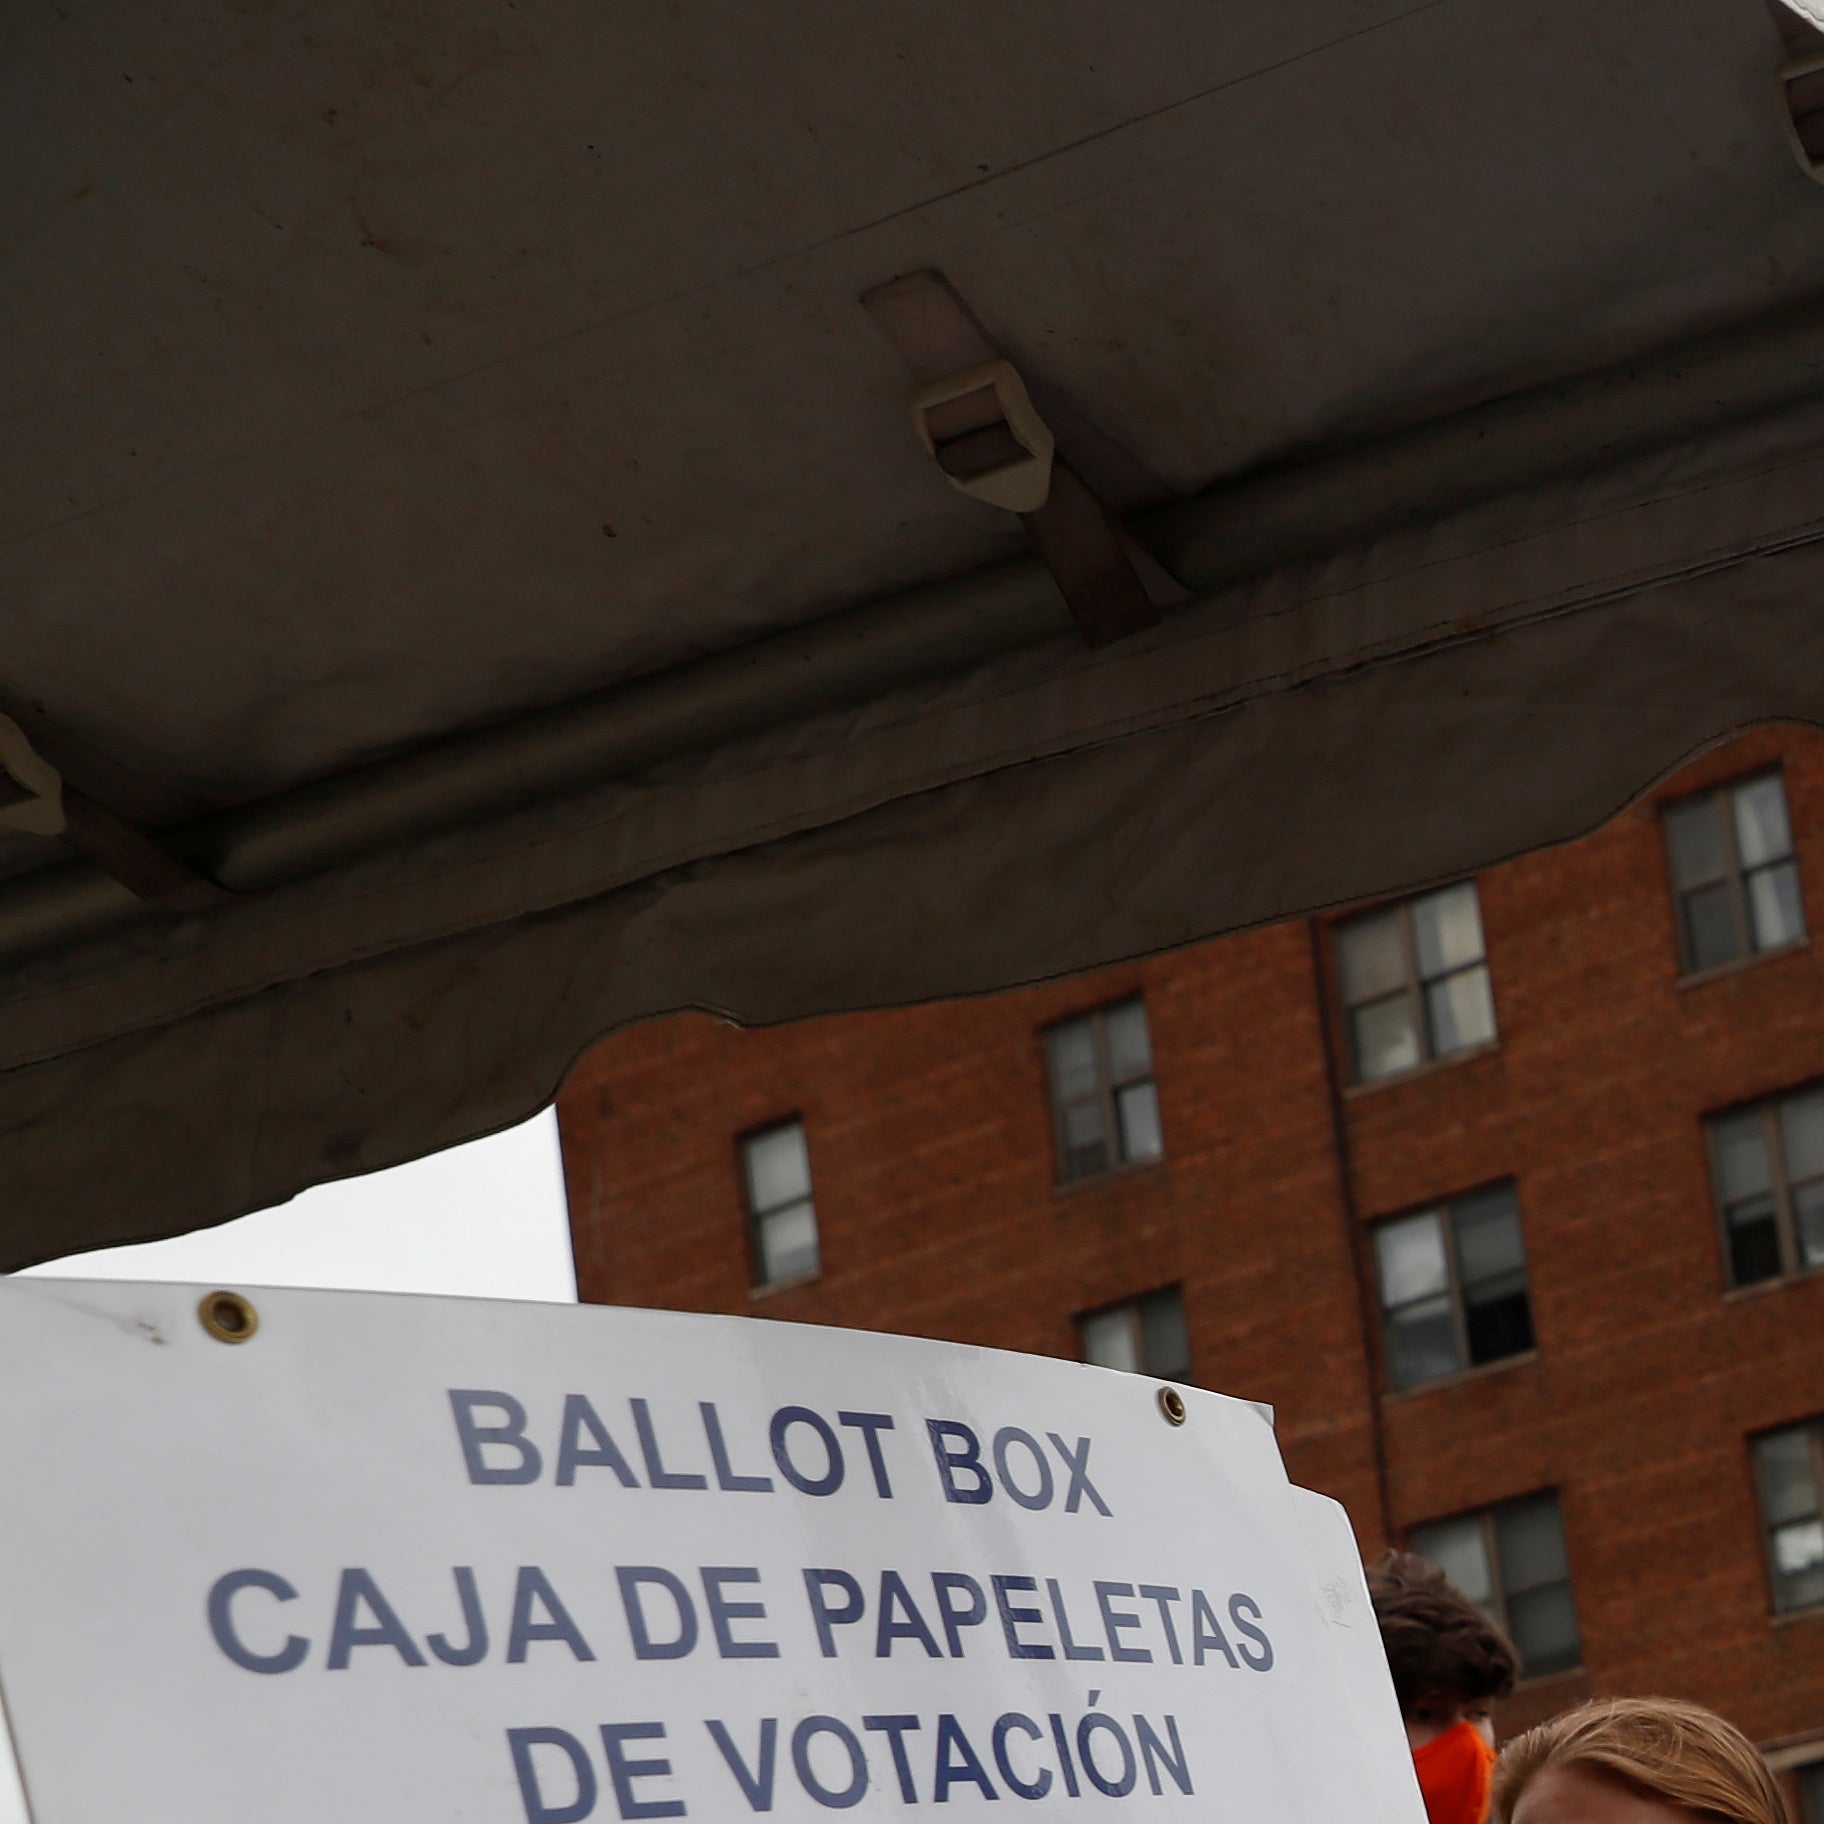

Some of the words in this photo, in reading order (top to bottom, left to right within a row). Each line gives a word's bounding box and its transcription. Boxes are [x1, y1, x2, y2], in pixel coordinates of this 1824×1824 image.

[447, 1387, 898, 1500] BALLOT
[923, 1417, 1114, 1518] BOX
[206, 1565, 598, 1676] CAJA
[614, 1564, 782, 1662] DE
[801, 1566, 1275, 1673] PAPELETAS
[703, 1688, 1196, 1813] VOTACIÓN
